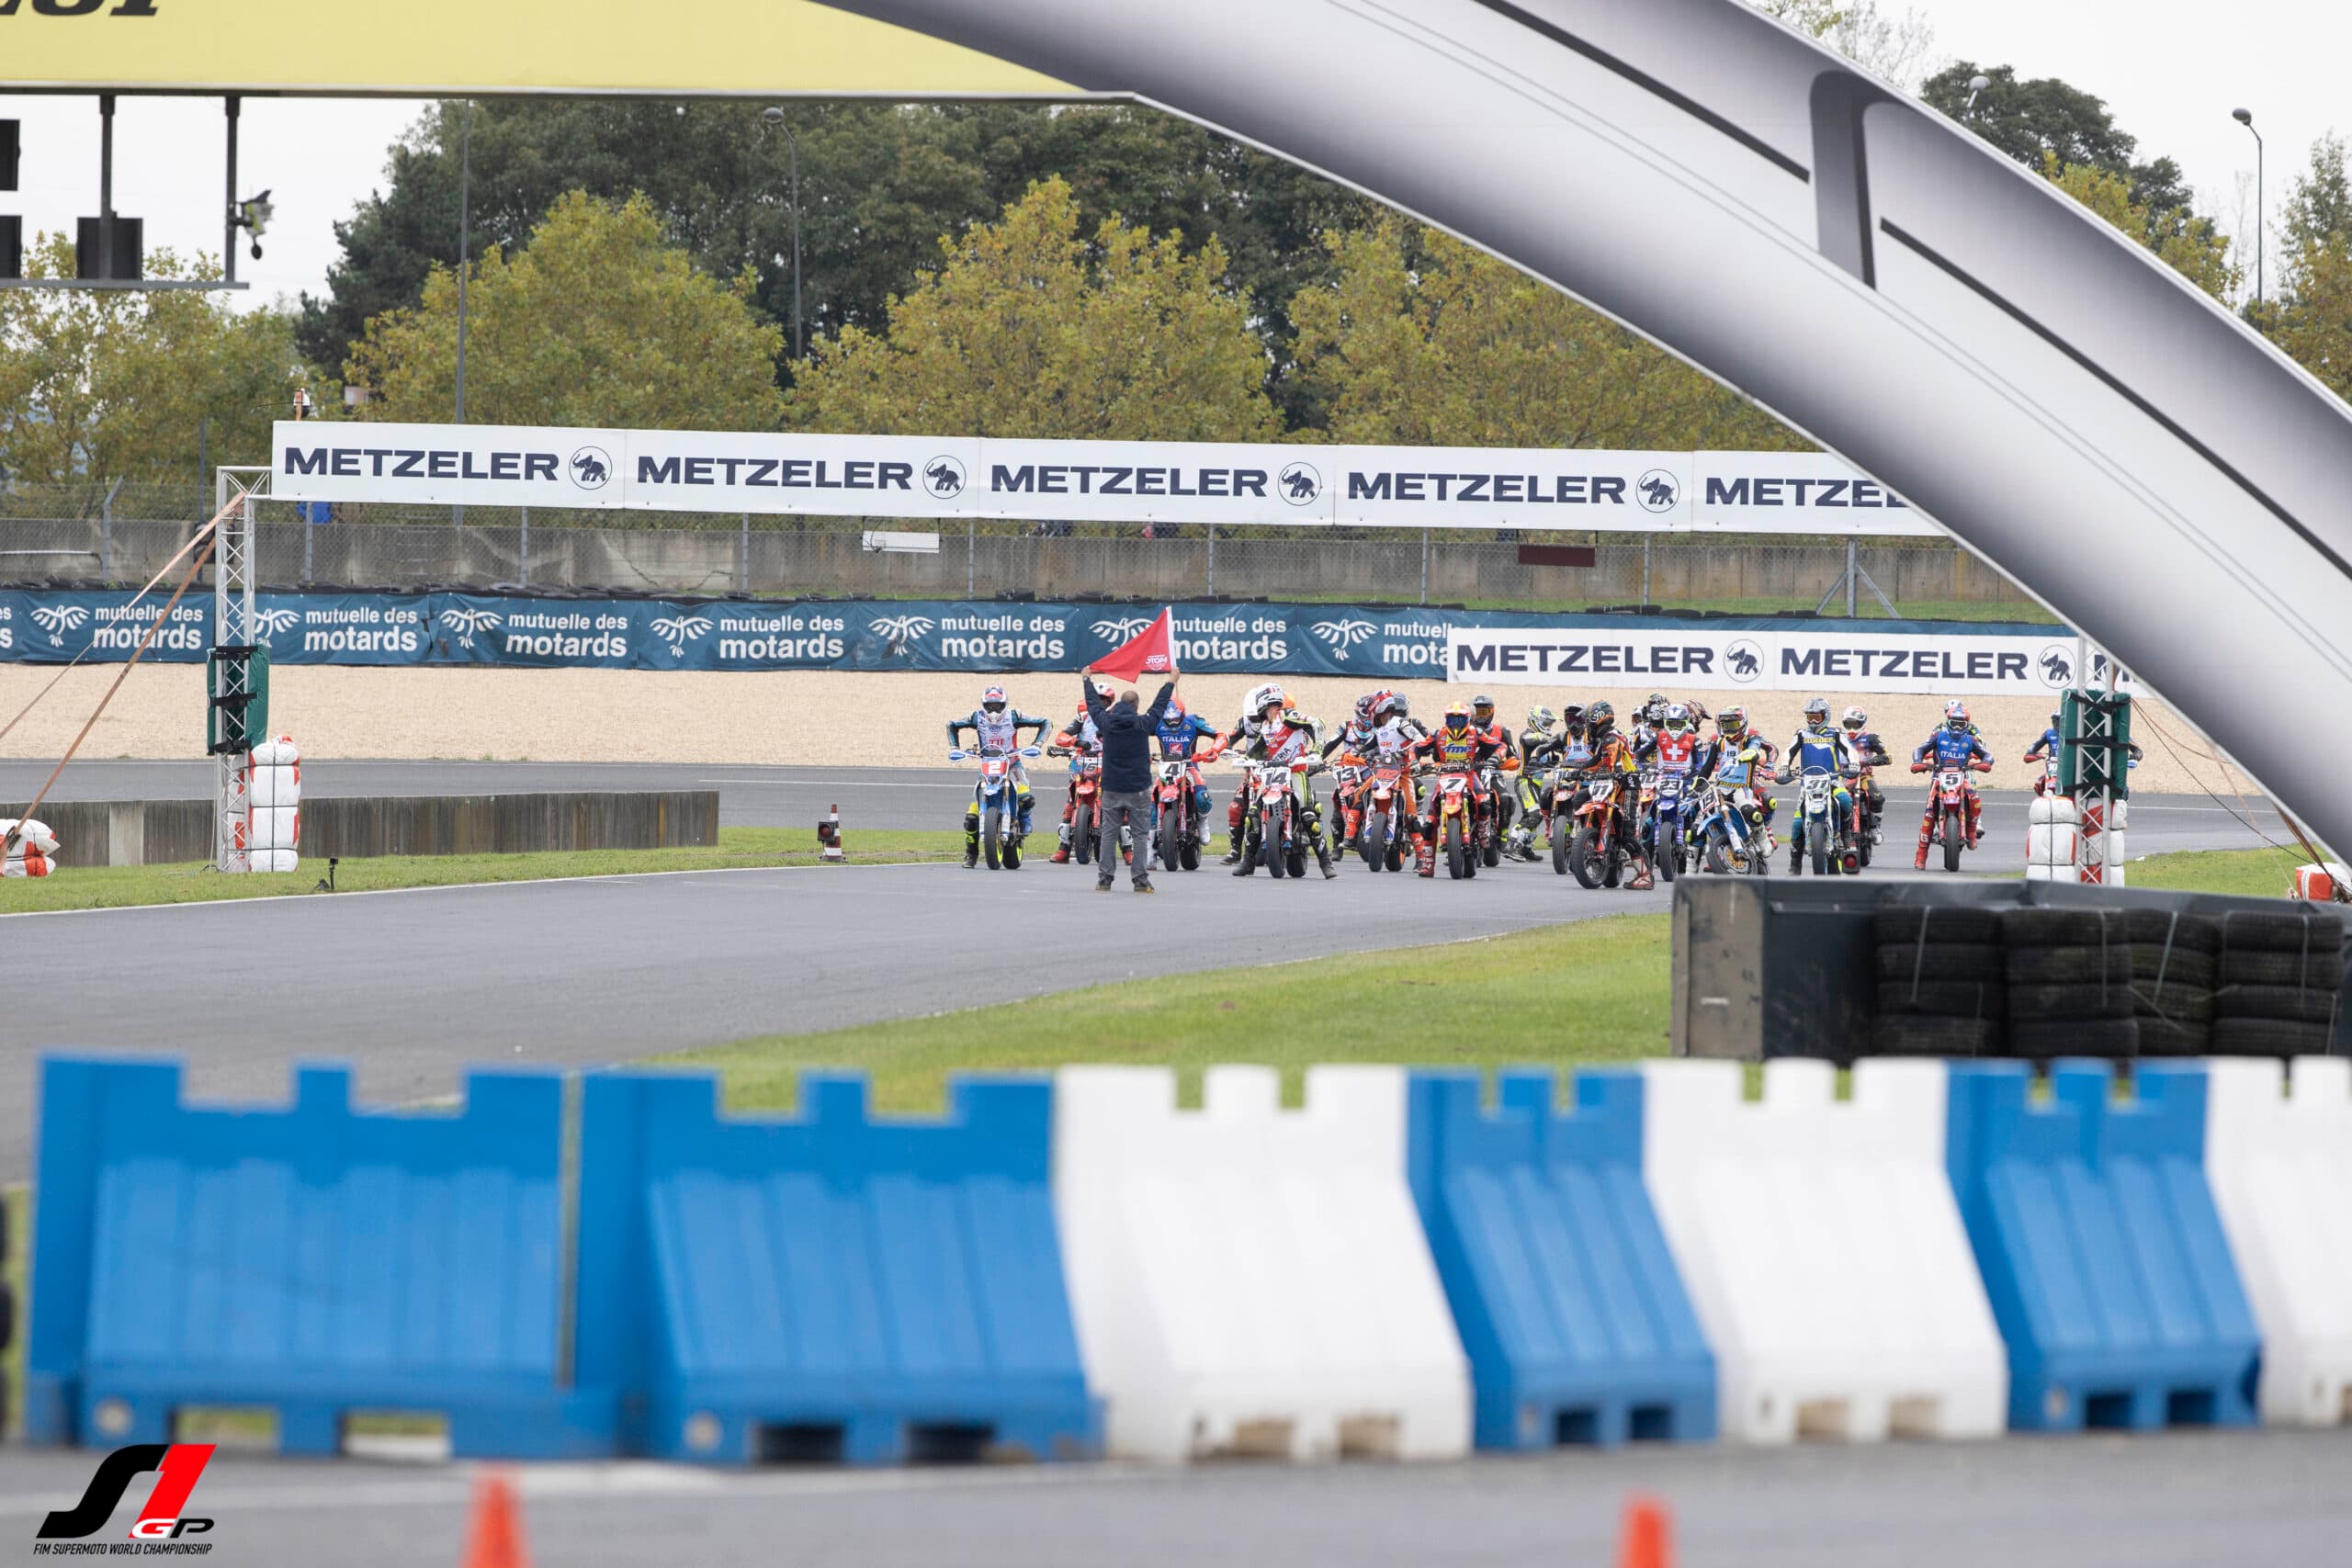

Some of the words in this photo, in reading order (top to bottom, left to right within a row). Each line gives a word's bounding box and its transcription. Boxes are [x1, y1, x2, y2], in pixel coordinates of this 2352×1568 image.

[286, 448, 559, 480] METZELER
[639, 457, 912, 490] METZELER
[992, 466, 1267, 496] METZELER
[1349, 473, 1625, 503] METZELER
[172, 605, 203, 622] des
[305, 607, 380, 624] mutuelle
[384, 607, 418, 624] des
[508, 614, 591, 629] mutuelle
[595, 614, 628, 629] des
[720, 615, 804, 632] mutuelle
[809, 615, 844, 631] des
[941, 615, 1024, 631] mutuelle
[1030, 615, 1065, 632] des
[1252, 617, 1287, 633] des
[93, 624, 202, 649] motards
[304, 626, 418, 651] motards
[506, 632, 628, 657] motards
[720, 634, 843, 659] motards
[942, 634, 1065, 659] motards
[1458, 646, 1713, 673] METZELER
[1782, 649, 2028, 679] METZELER
[1940, 750, 1966, 759] ITALIA
[989, 761, 1001, 775] 2
[1165, 763, 1179, 776] 4
[1337, 767, 1354, 784] 13
[1265, 772, 1287, 785] 14
[1445, 779, 1462, 790] 7
[1945, 773, 1958, 785] 5
